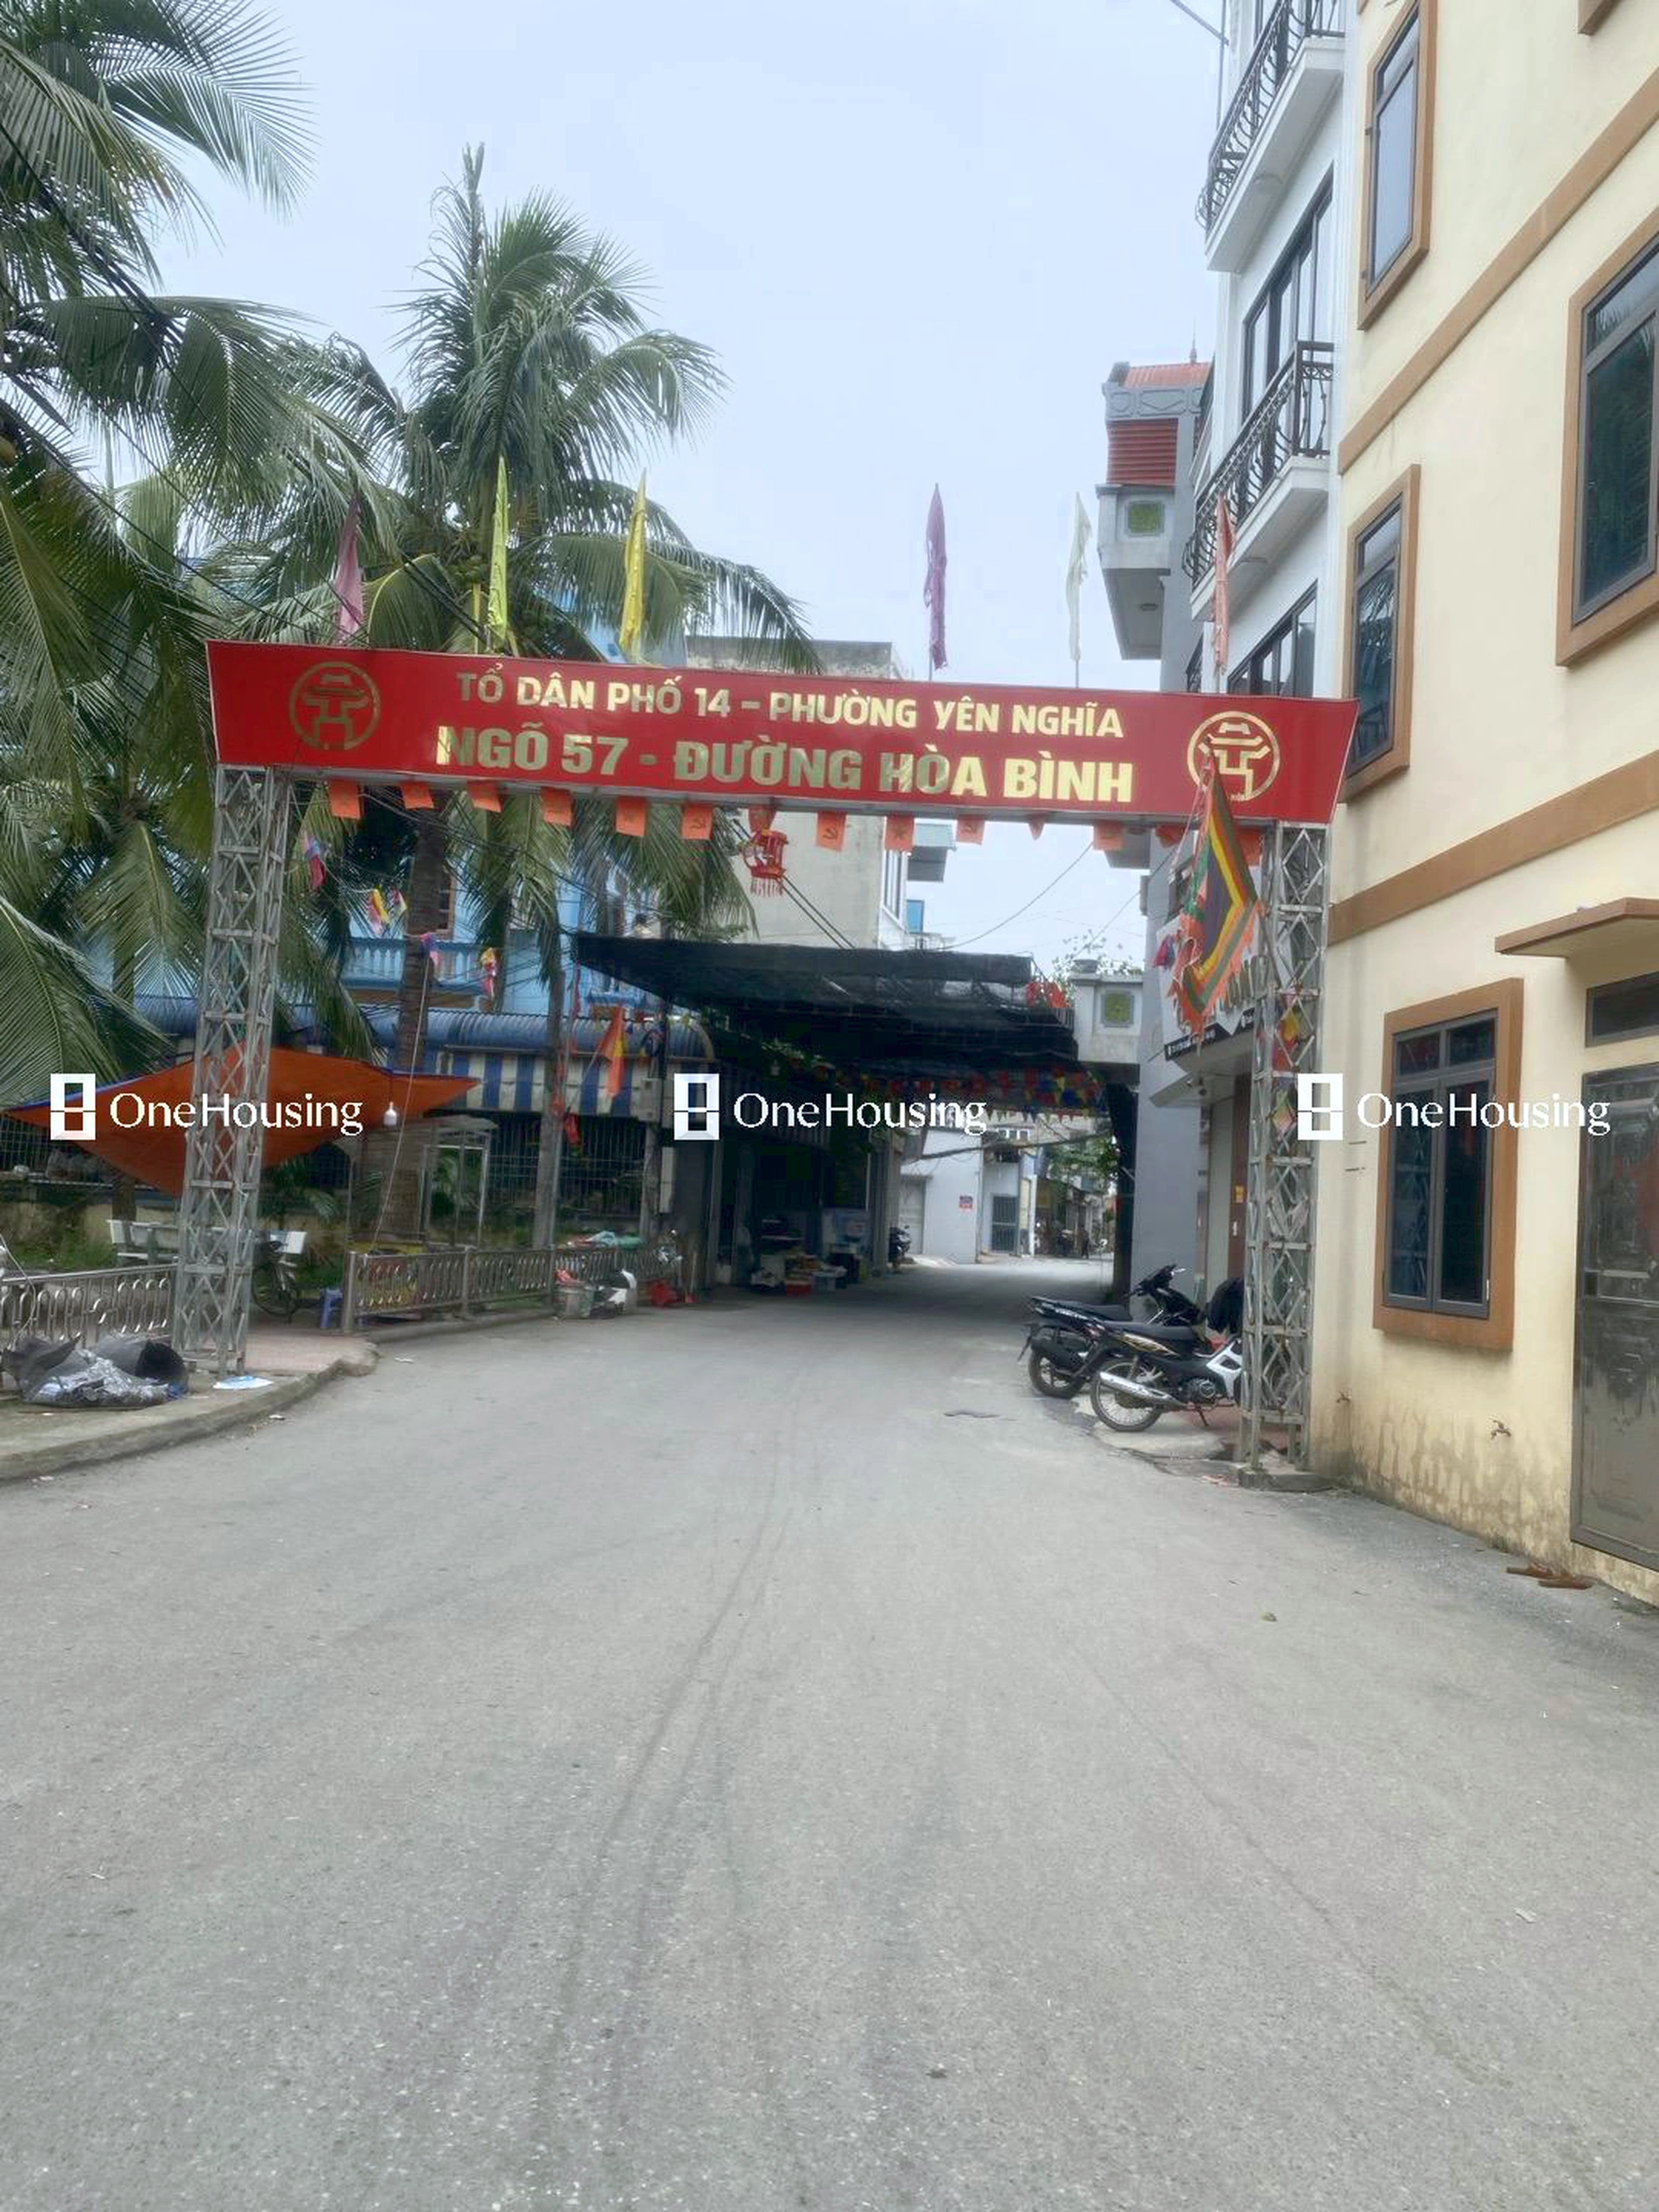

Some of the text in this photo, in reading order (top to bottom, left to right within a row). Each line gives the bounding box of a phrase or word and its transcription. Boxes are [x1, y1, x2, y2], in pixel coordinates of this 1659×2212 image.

[457, 663, 504, 703] TỔ
[516, 672, 596, 710] DÂN
[606, 675, 682, 714] PHỐ
[694, 688, 731, 718] 14
[769, 688, 917, 728] PHƯỜNG
[933, 695, 1000, 732] YÊN
[1011, 701, 1124, 738] NGHĨA
[436, 721, 549, 771] NGÕ
[561, 735, 629, 776] 57
[673, 735, 861, 790] ĐƯỜNG
[878, 744, 988, 797] HÒA
[1003, 751, 1133, 802] BÌNH
